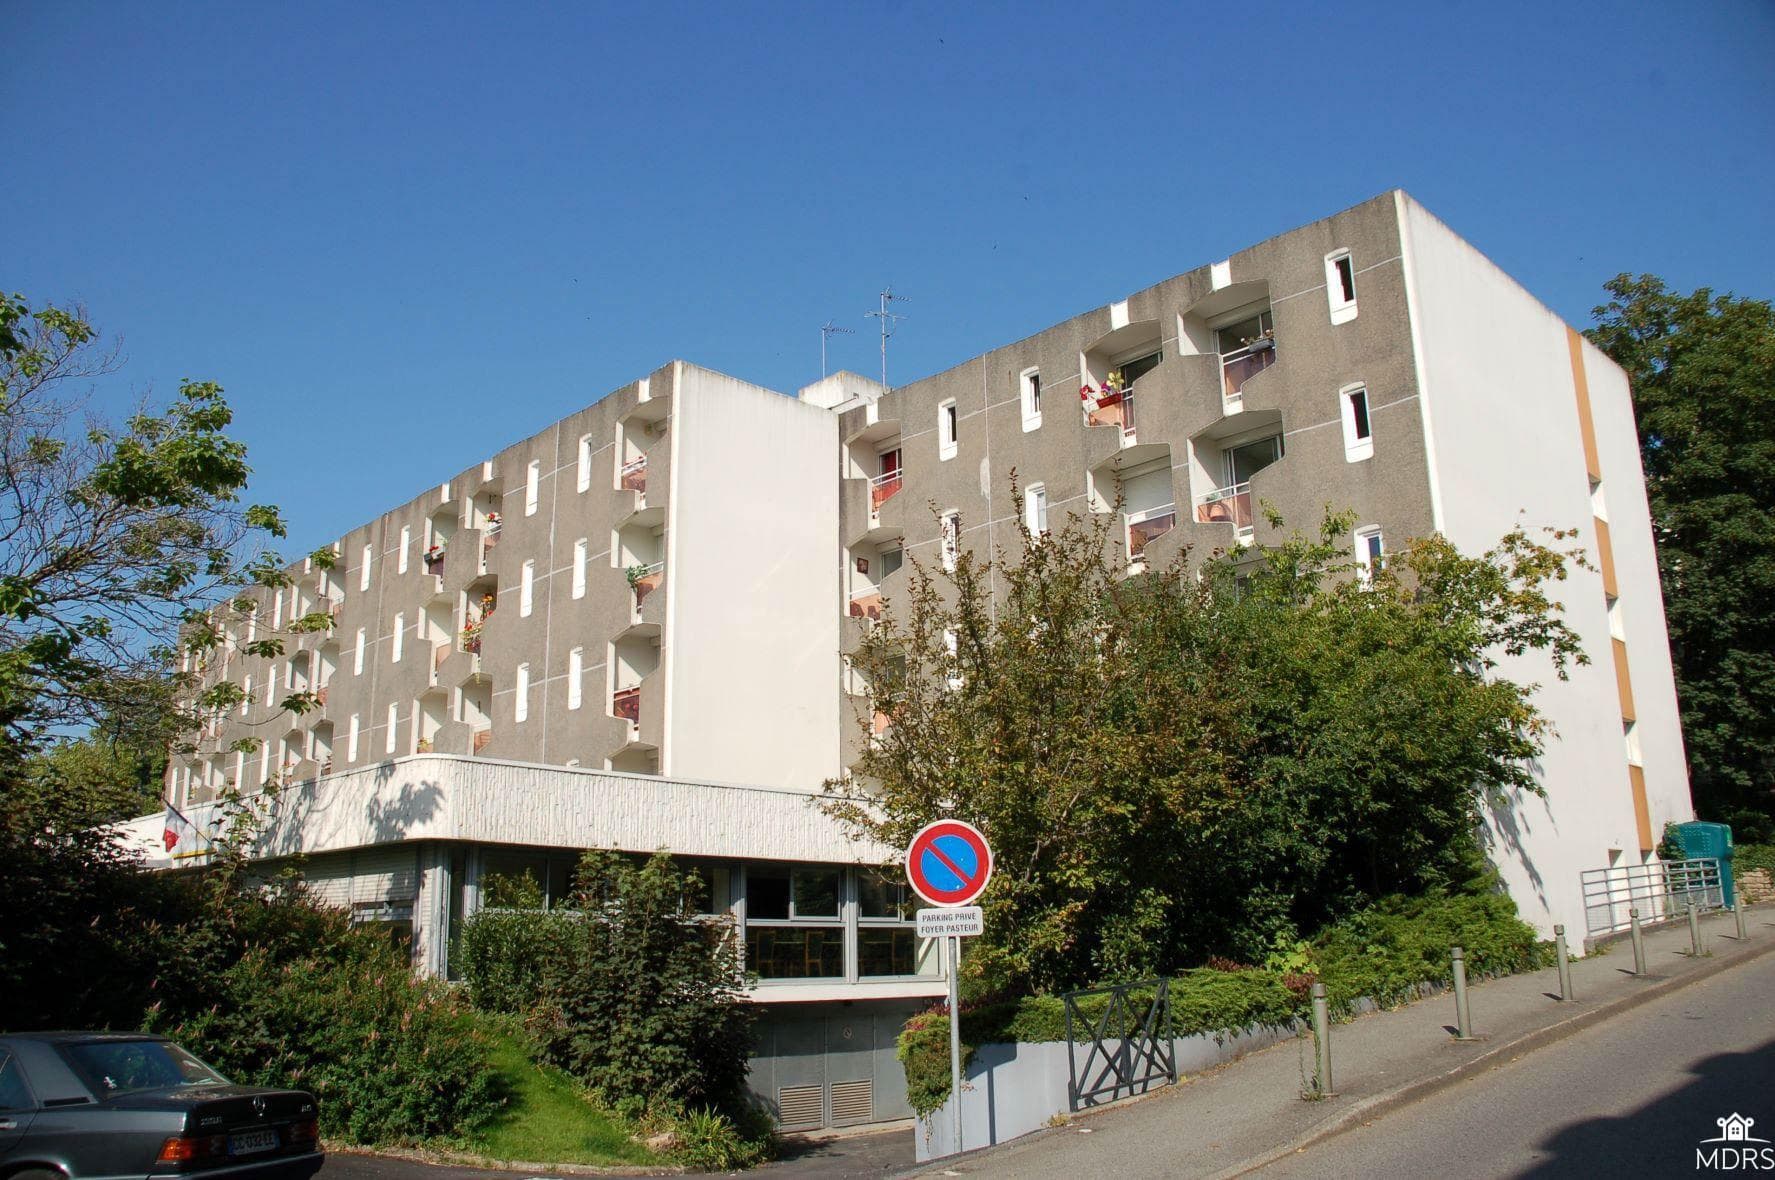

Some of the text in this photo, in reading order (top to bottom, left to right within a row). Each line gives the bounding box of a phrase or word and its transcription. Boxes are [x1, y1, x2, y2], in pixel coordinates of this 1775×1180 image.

[922, 914, 953, 922] PARKING
[921, 923, 978, 933] FOYER PASTEUR
